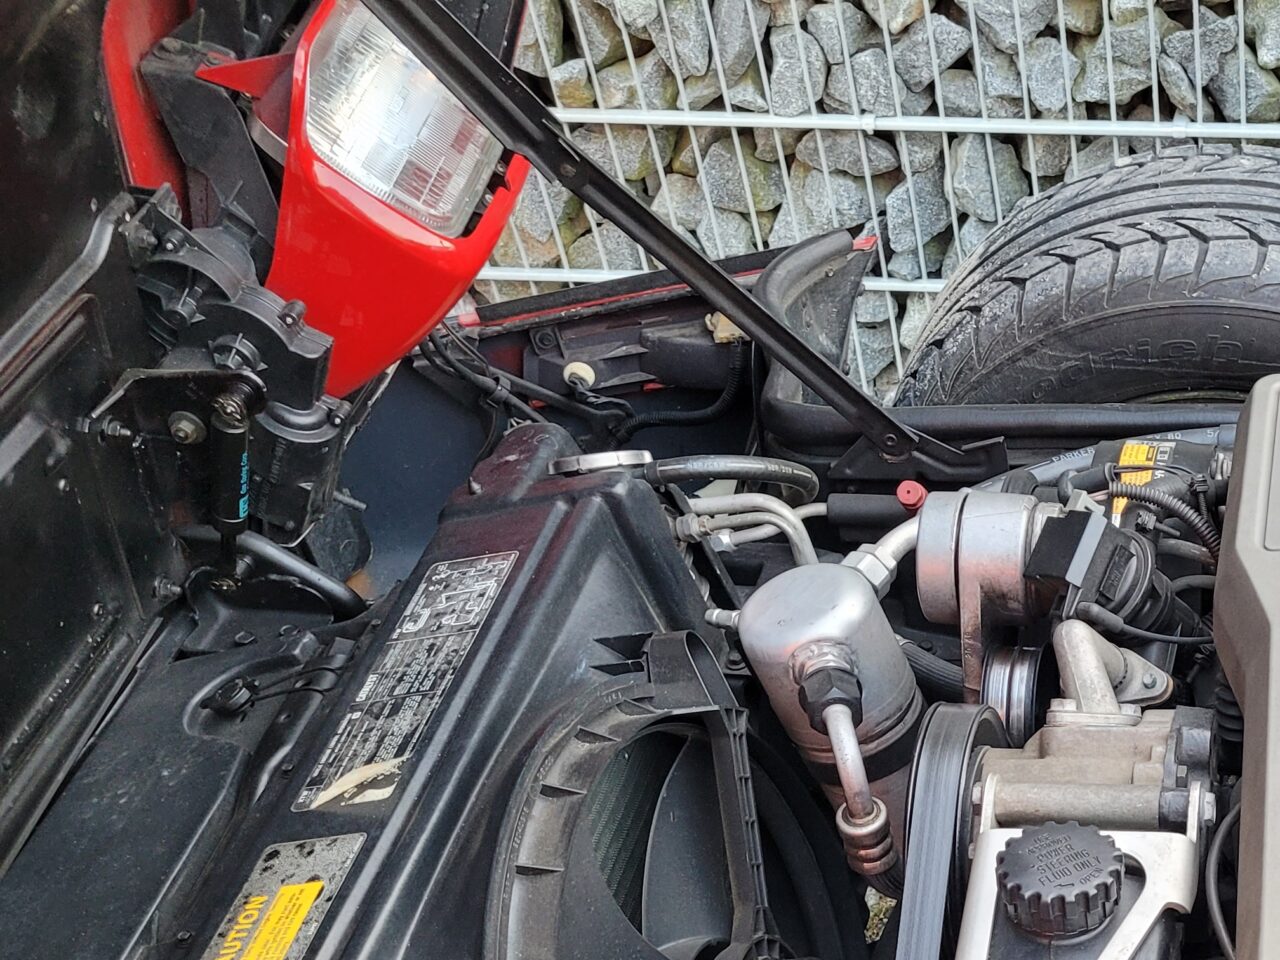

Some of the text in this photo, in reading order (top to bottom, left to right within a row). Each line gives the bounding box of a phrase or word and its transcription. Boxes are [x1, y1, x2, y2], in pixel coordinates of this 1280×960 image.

[1051, 446, 1095, 463] PARKER
[1035, 848, 1090, 874] STEERING
[1036, 844, 1075, 863] POWER
[1037, 854, 1102, 887] FLUID ONLY
[1079, 868, 1104, 885] OPEN
